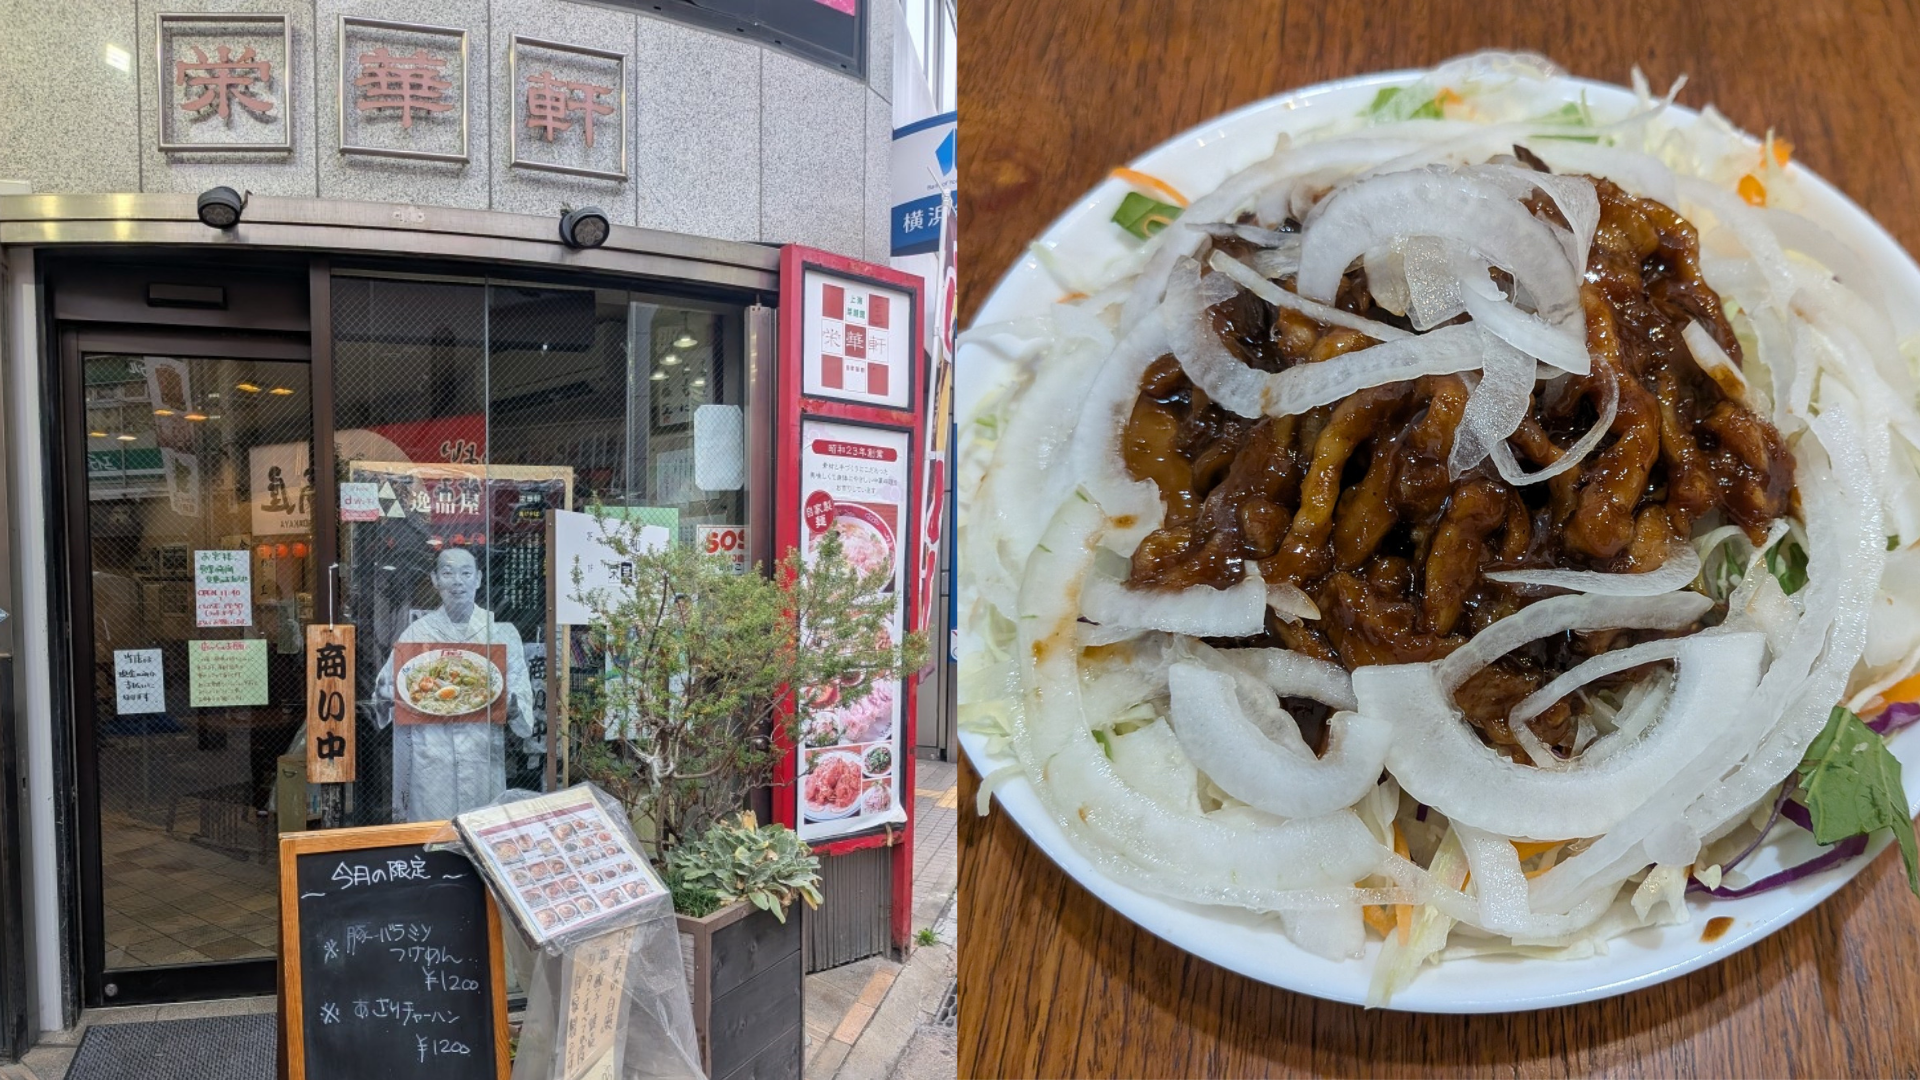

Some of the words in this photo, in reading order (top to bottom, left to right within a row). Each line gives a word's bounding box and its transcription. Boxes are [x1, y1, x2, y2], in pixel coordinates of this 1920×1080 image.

[176, 45, 615, 147] 栄華軒
[903, 203, 957, 234] 横浜
[822, 328, 886, 355] 栄華軒
[316, 643, 347, 760] 商い中
[331, 855, 431, 890] 今月の限定
[422, 967, 479, 991] ¥1200
[416, 1034, 471, 1063] ¥1200
